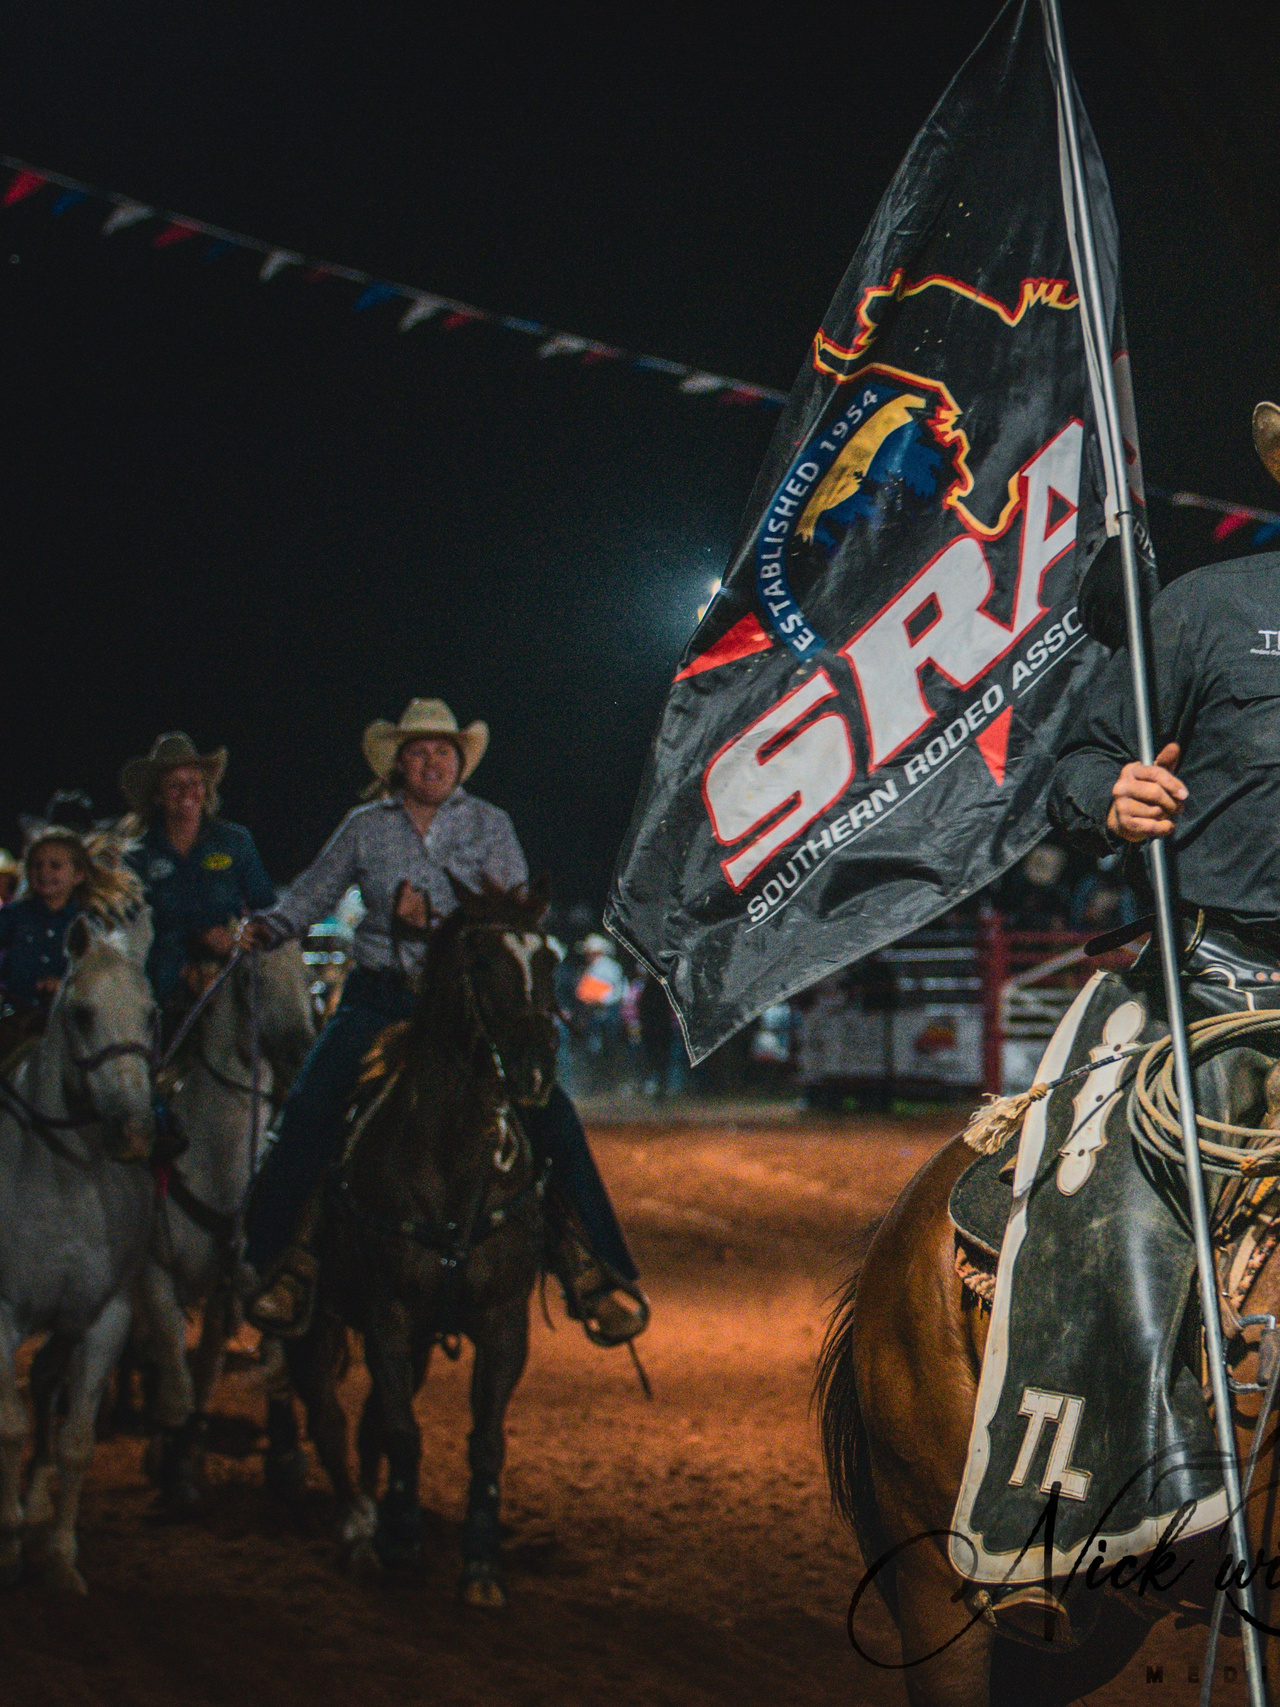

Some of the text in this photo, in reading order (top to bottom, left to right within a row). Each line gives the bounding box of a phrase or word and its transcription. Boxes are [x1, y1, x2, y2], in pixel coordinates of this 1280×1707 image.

[760, 389, 879, 652] ESTABLISHED 1954
[702, 414, 1085, 893] SRA
[745, 779, 900, 924] SOUTHERN
[904, 684, 1006, 786] RODEO
[1008, 1387, 1093, 1502] TL
